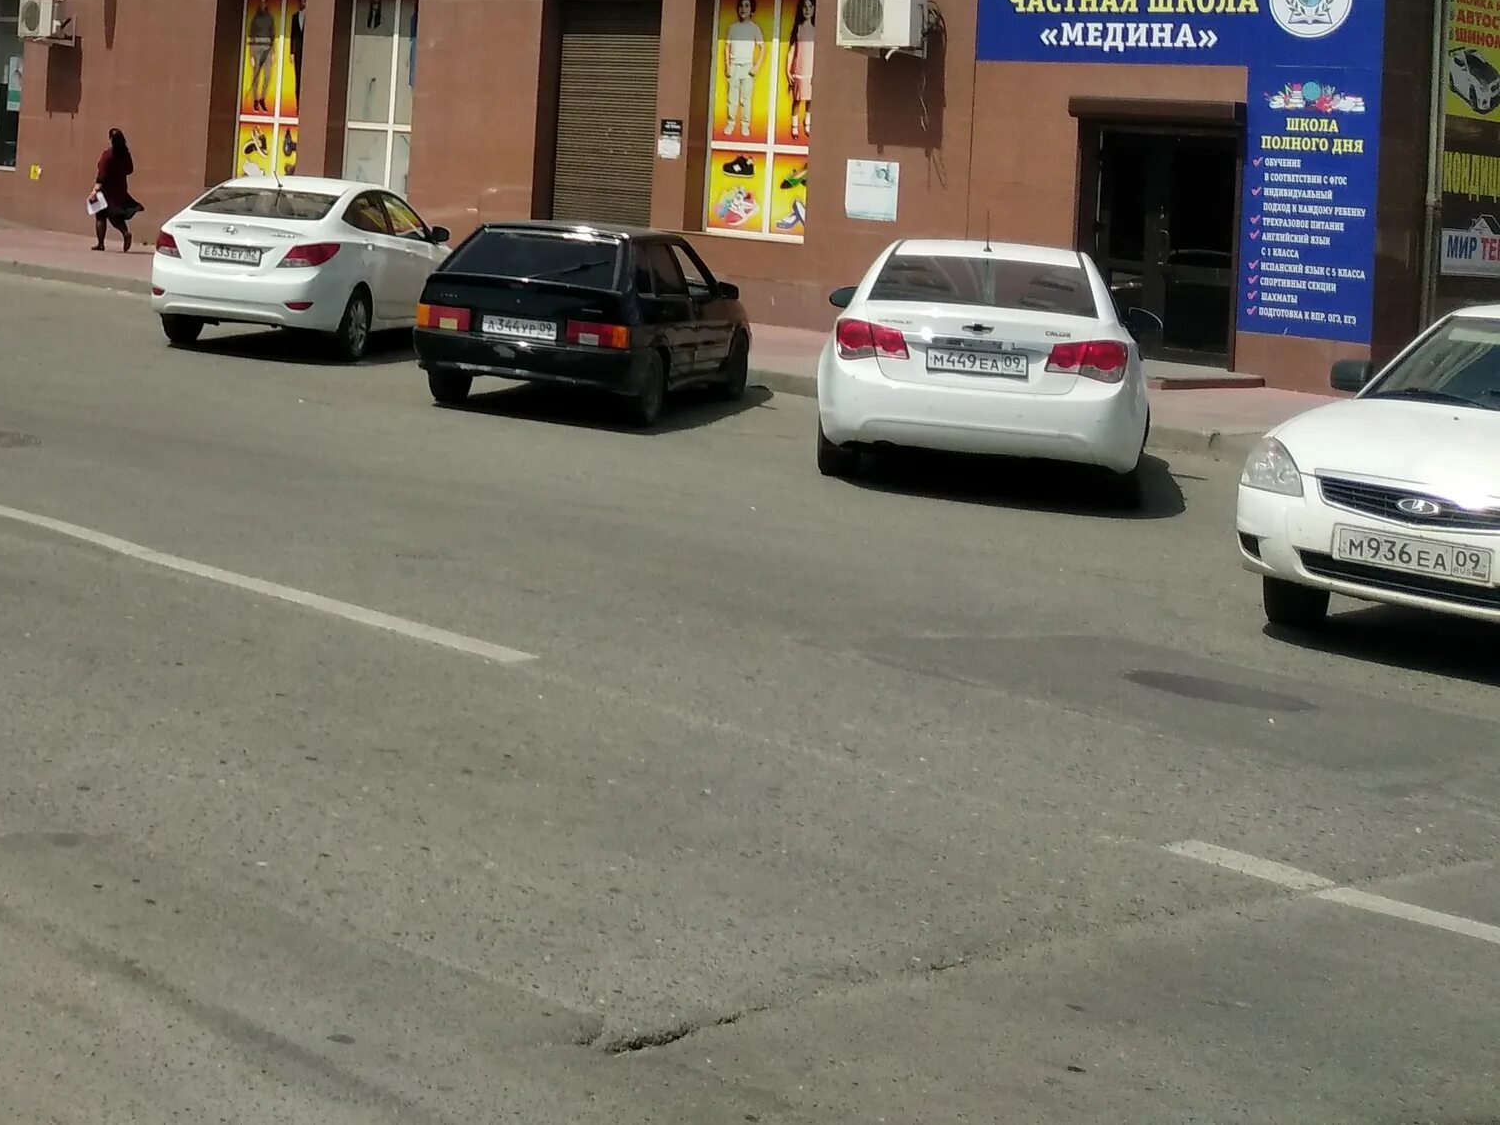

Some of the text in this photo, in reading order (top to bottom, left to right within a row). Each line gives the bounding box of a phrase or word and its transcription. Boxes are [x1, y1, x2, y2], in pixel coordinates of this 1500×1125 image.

[1040, 22, 1218, 52] «МЕДИНА»
[1286, 117, 1338, 132] ШКОЛА
[1261, 136, 1363, 154] ПОЛНОГО ДНЯ
[1264, 158, 1301, 167] ОБУЧЕНИЕ
[1270, 173, 1321, 184] СООТВЕТСТВИИ
[1323, 176, 1328, 184] С
[1329, 176, 1347, 185] ФГОС
[1264, 187, 1332, 200] ИНДИВИДУАЛЬНЫЙ
[1263, 203, 1366, 217] ПОДХОД К КАЖДОМУ РЕБЕНКУ
[1262, 218, 1344, 231] ТРЕХРАЗОВОЕ ПИТАНИЕ
[1262, 232, 1330, 245] АНГЛИЙСКИЙ ЯЗЫК
[1261, 247, 1266, 255] С
[1273, 248, 1299, 258] КЛАССА
[1447, 235, 1478, 260] МИР
[1260, 262, 1303, 273] ИСПАНСКИЙ
[1304, 266, 1325, 275] ЯЗЫК
[1338, 268, 1366, 279] КЛАССА
[1260, 277, 1337, 293] СПОРТИВНЫЕ СЕКЦИИ
[1261, 292, 1298, 303] ШАХМАТЫ
[1259, 307, 1303, 318] ПОДГОТОВКА
[1304, 311, 1309, 320] К
[1344, 315, 1357, 325] ЕГЭ
[487, 318, 536, 335] А344УР
[933, 352, 1021, 371] М449ЕА 09
[1349, 537, 1480, 571] М936ЕА 09
[1453, 567, 1471, 575] RUS
